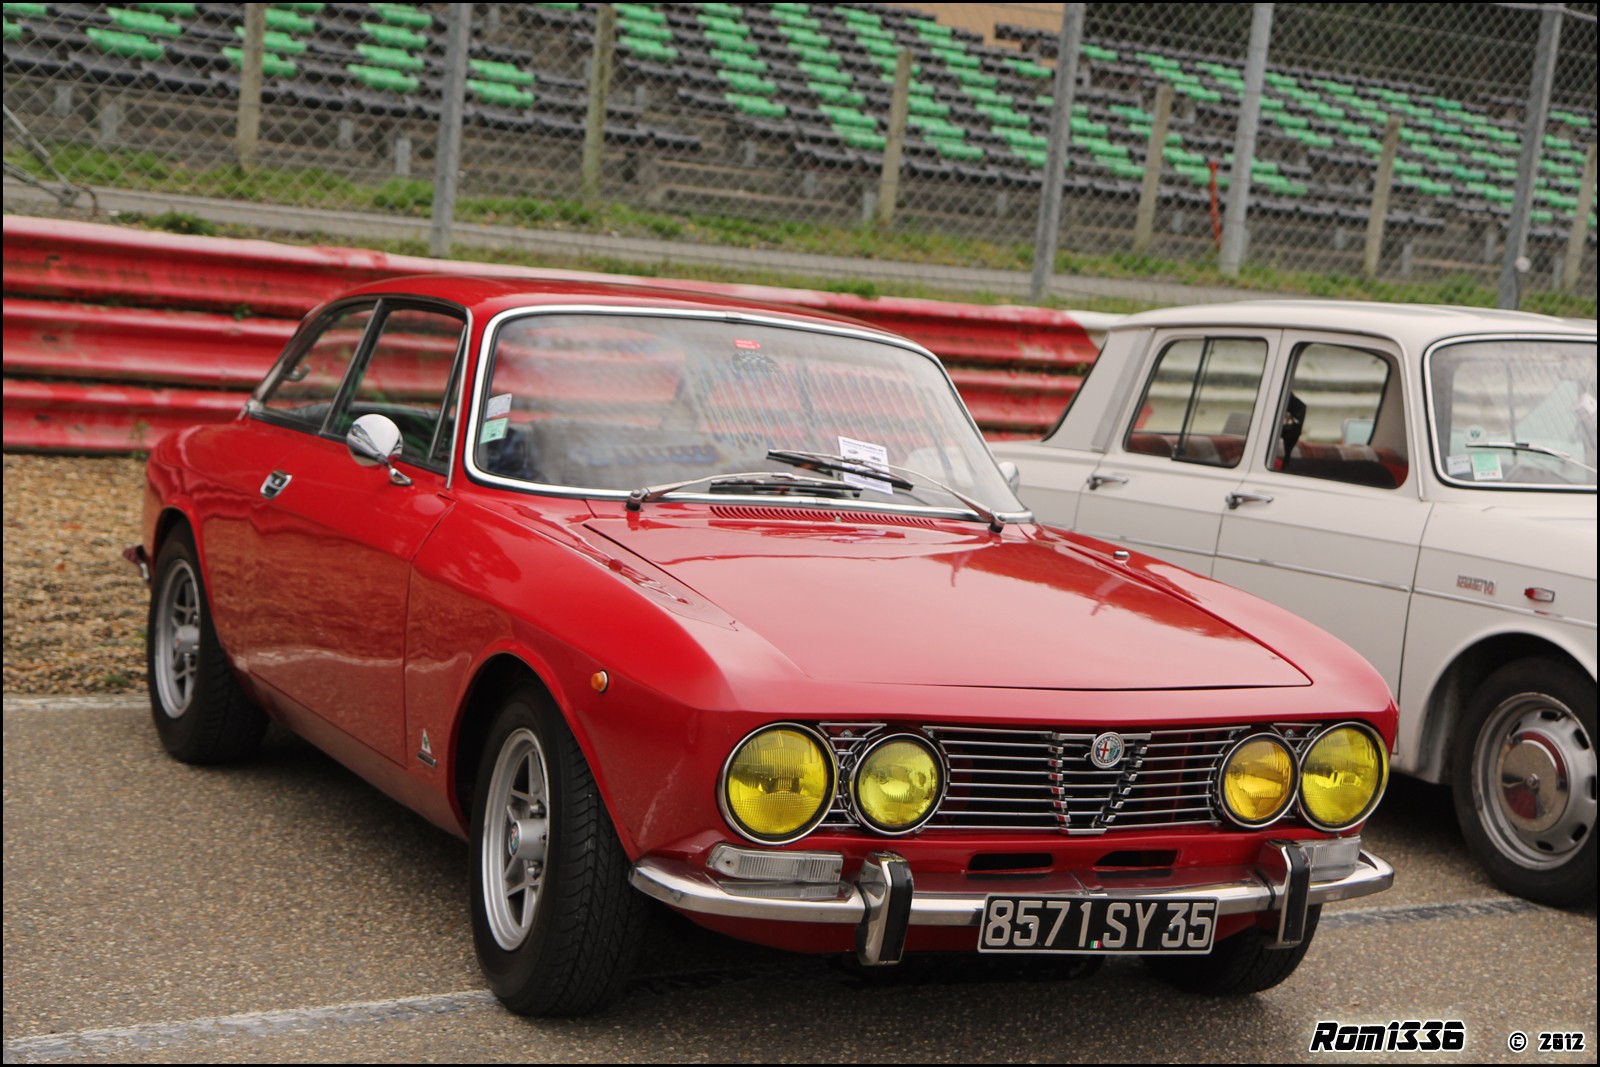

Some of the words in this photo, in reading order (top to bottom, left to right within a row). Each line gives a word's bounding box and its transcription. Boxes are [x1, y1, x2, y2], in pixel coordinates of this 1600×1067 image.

[985, 899, 1092, 947] 8571
[1102, 902, 1158, 948] SY
[1161, 902, 1215, 948] 35
